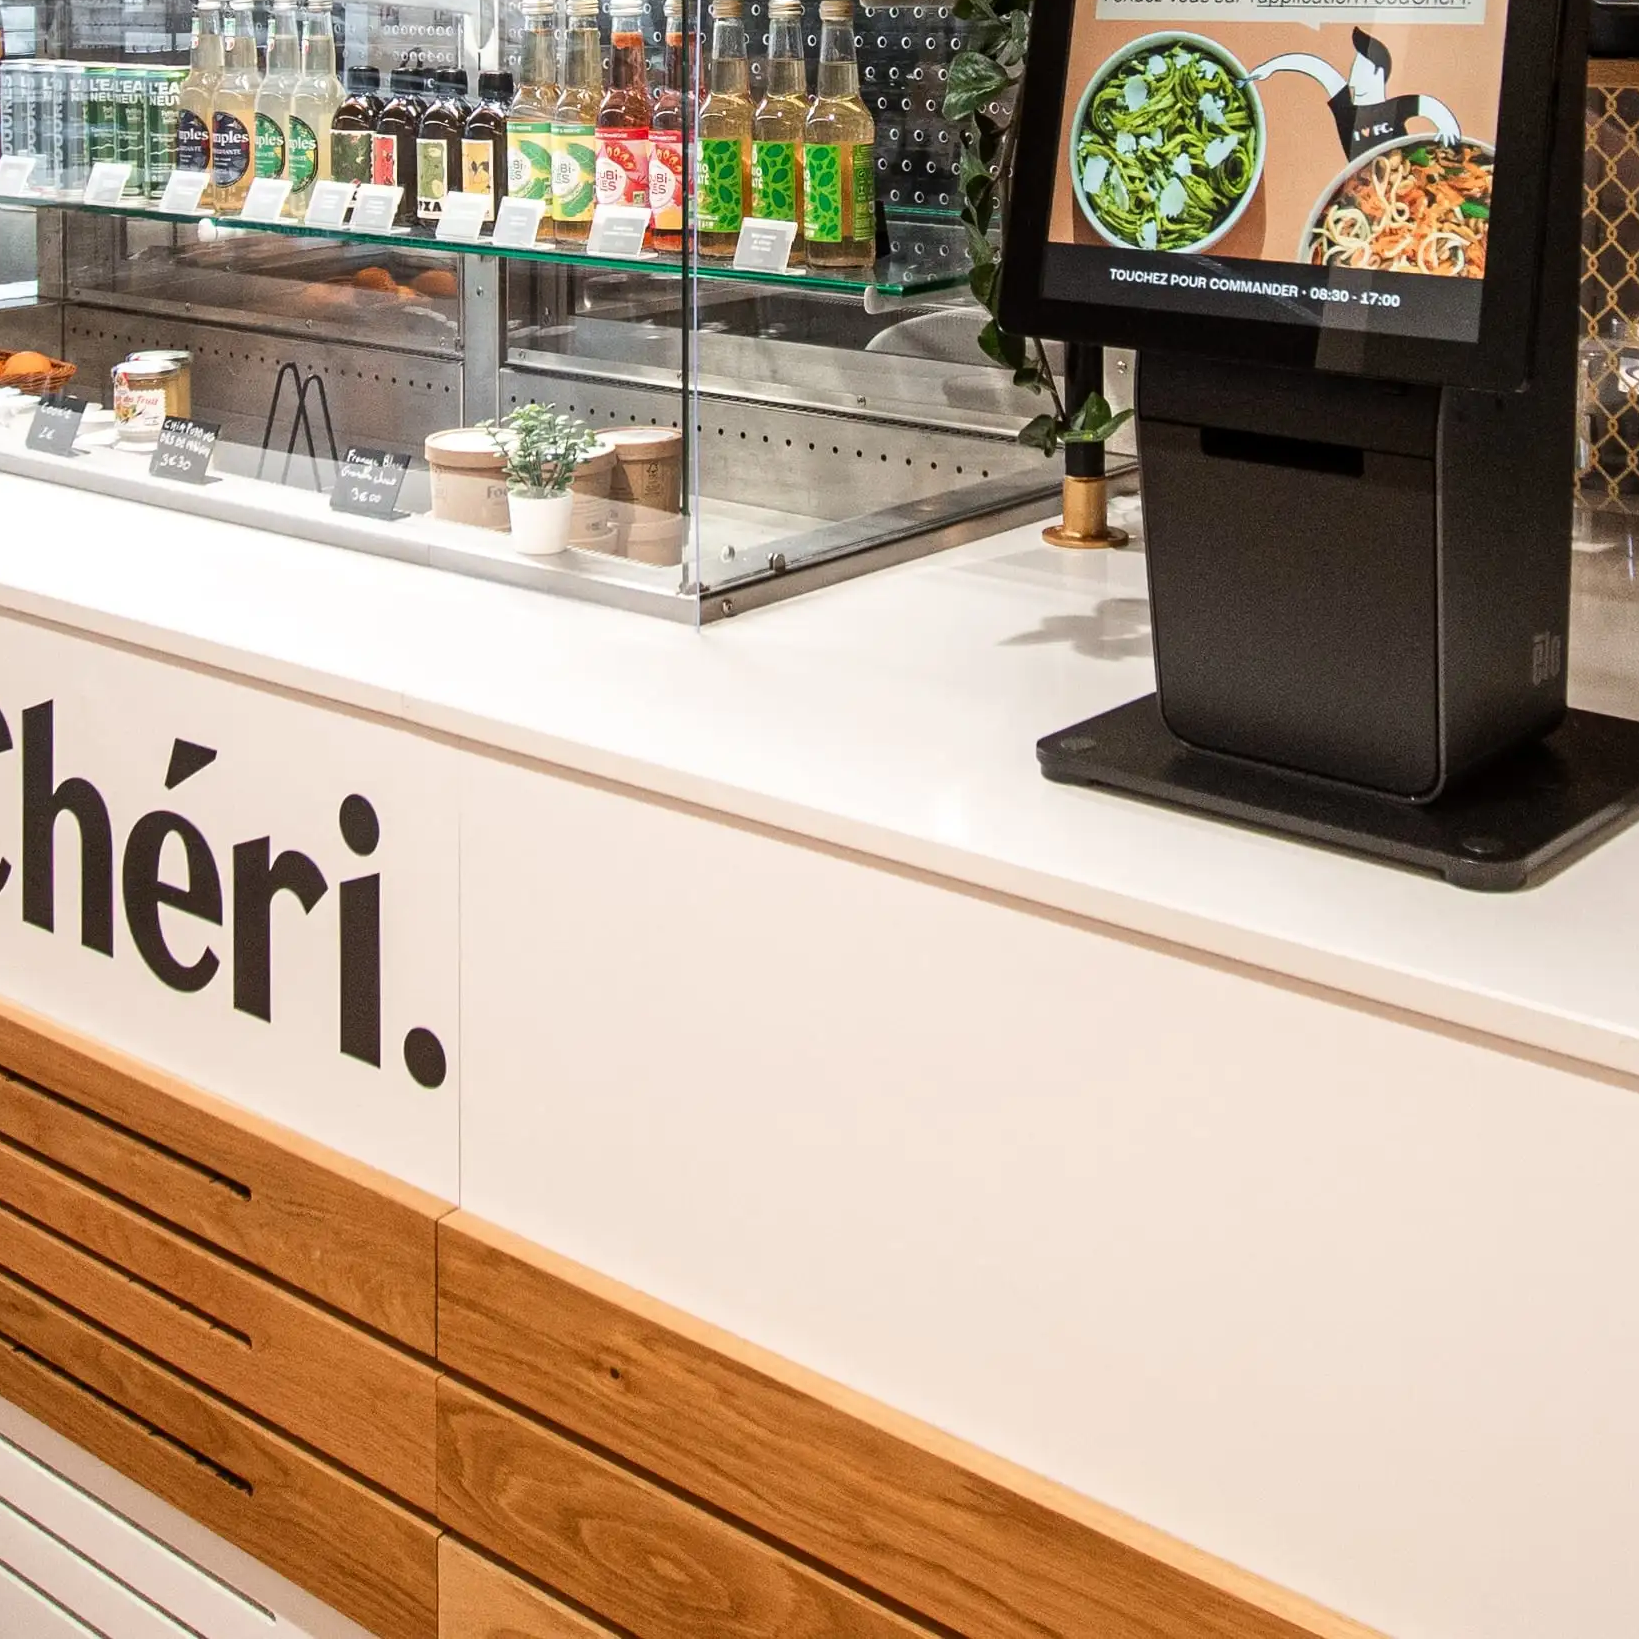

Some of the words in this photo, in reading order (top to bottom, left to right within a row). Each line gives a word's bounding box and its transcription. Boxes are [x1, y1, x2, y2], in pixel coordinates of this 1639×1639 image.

[1110, 268, 1169, 286] TOUCHEZ
[1170, 273, 1207, 290] POUR
[1209, 278, 1299, 298] COMMANDER
[1309, 287, 1350, 303] 08:30
[1360, 292, 1401, 308] 17:00
